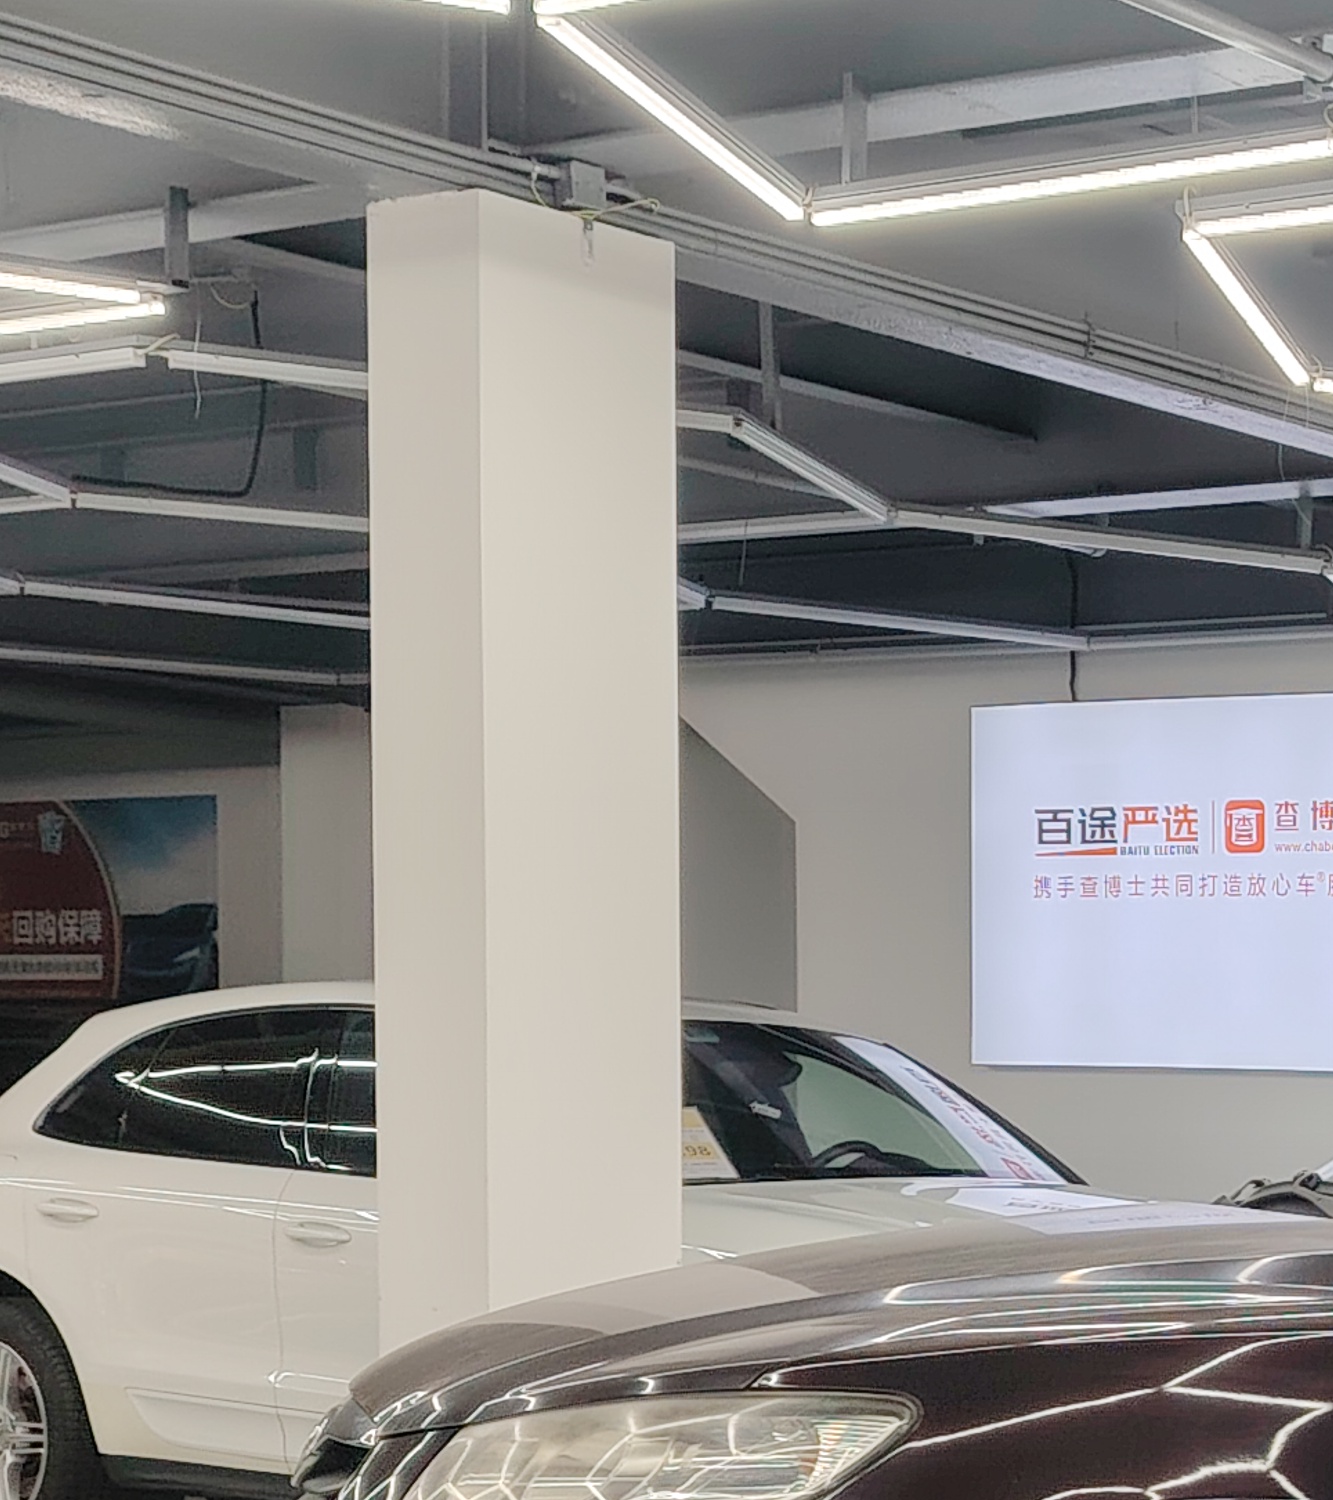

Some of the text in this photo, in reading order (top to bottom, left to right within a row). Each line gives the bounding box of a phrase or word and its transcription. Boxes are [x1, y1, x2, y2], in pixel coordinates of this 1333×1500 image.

[1034, 804, 1199, 845] 百途严选
[1120, 846, 1150, 856] BAITU
